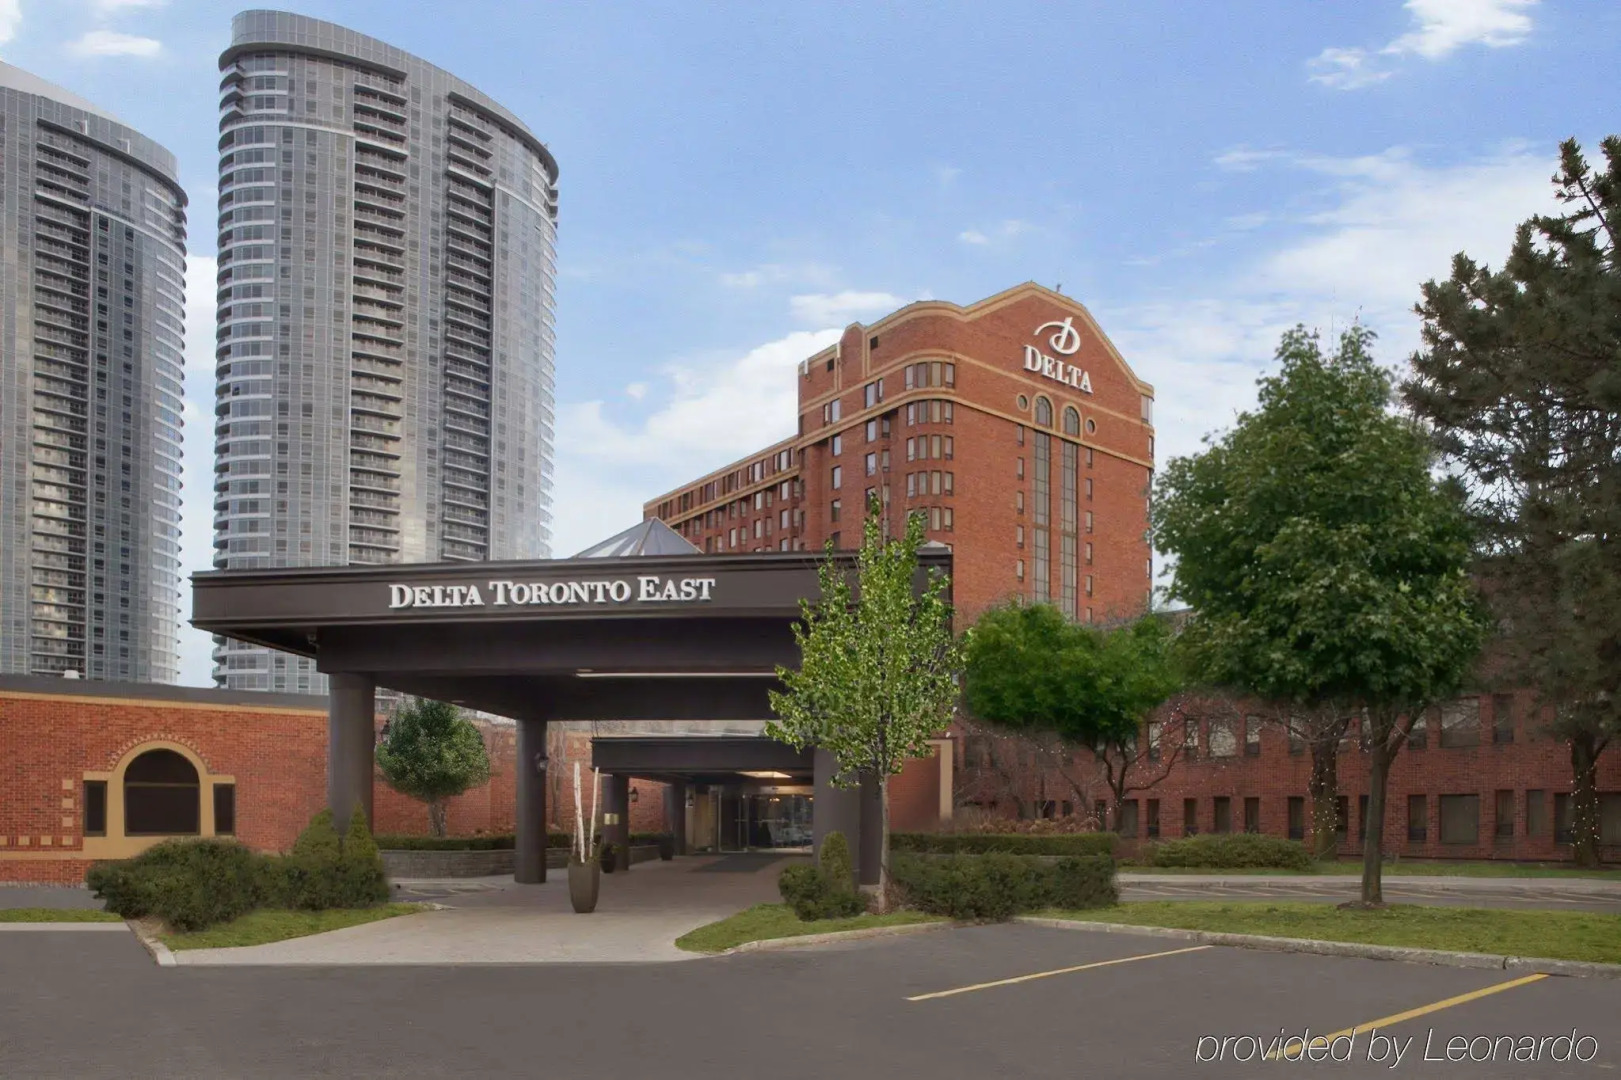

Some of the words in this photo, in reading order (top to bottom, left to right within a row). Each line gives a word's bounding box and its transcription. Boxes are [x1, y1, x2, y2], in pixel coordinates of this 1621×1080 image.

[1023, 344, 1094, 394] DELTA
[388, 584, 485, 608] DELTA
[488, 580, 631, 605] TORONTO
[637, 576, 716, 602] EAST
